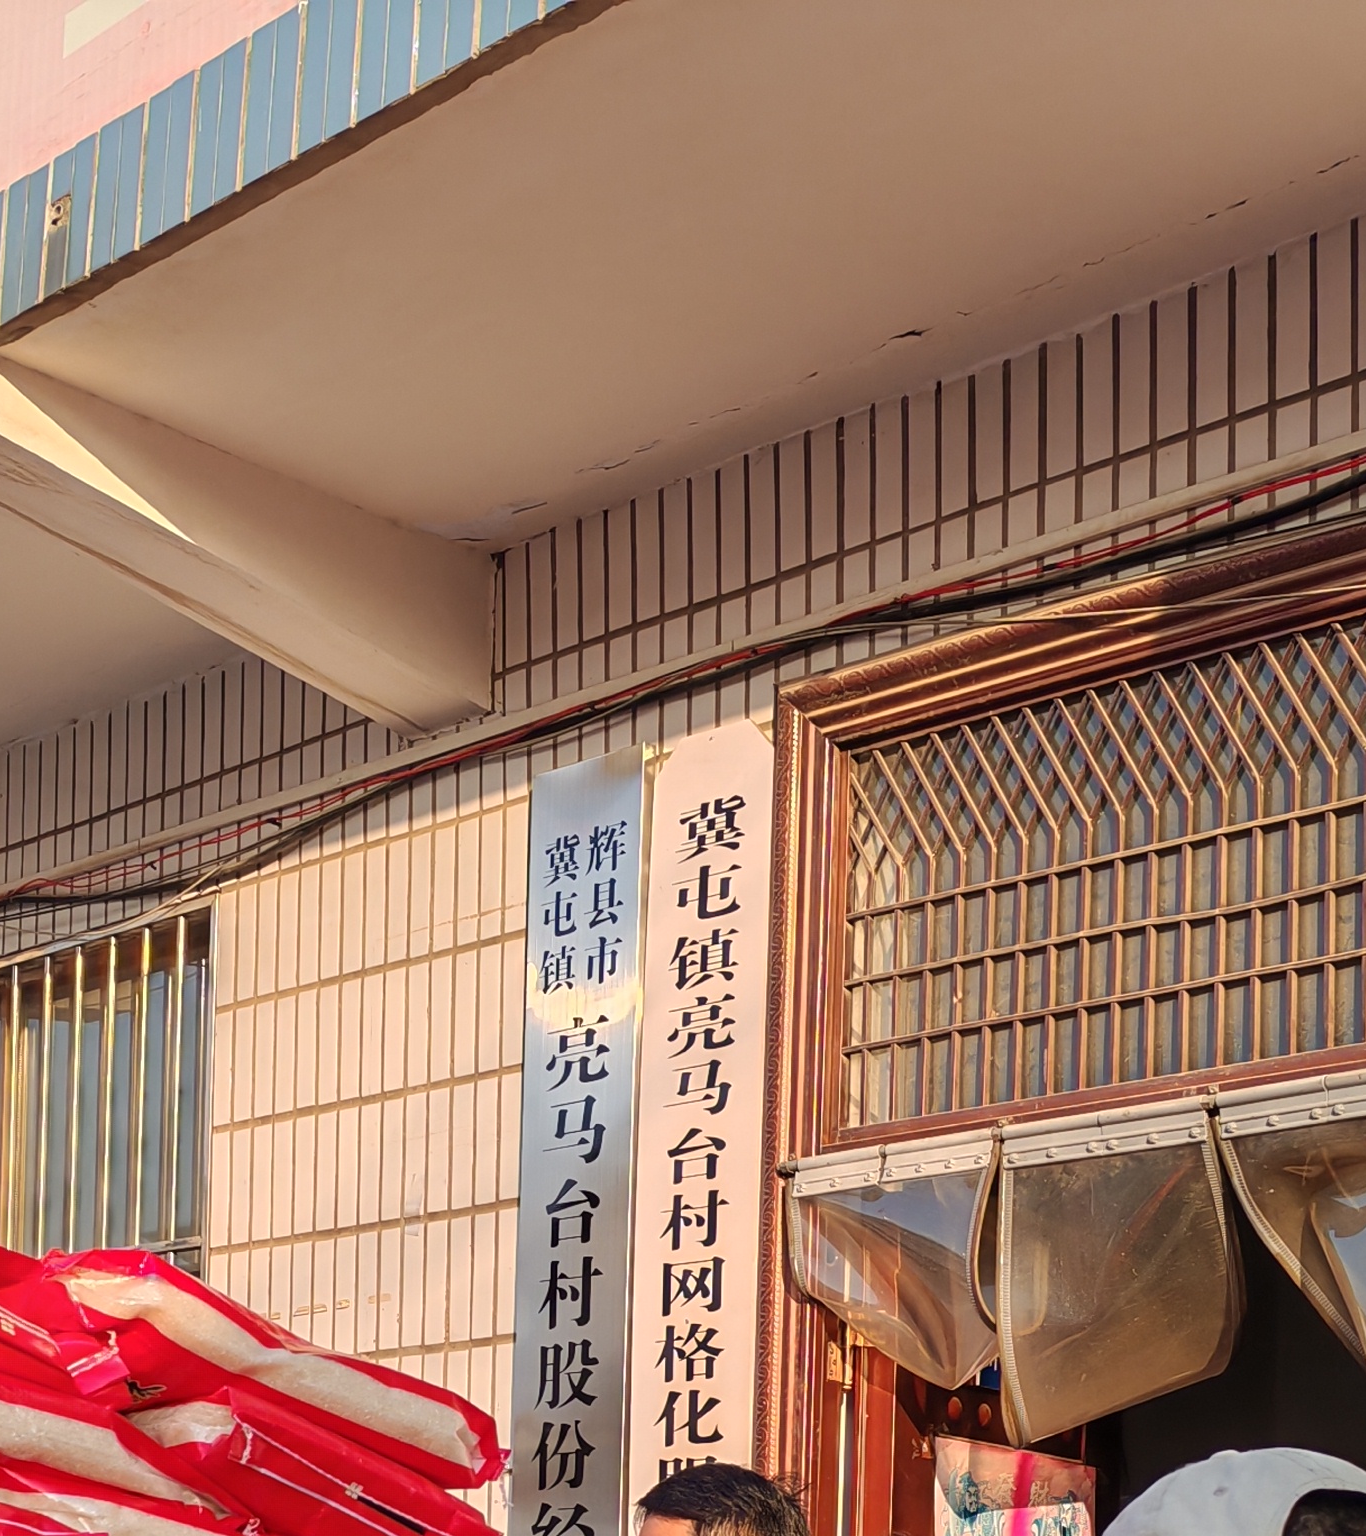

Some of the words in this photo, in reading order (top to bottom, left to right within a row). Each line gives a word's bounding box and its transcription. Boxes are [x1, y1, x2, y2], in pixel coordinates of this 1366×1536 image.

[538, 834, 581, 996] 冀屯镇
[585, 819, 628, 986] 辉县市
